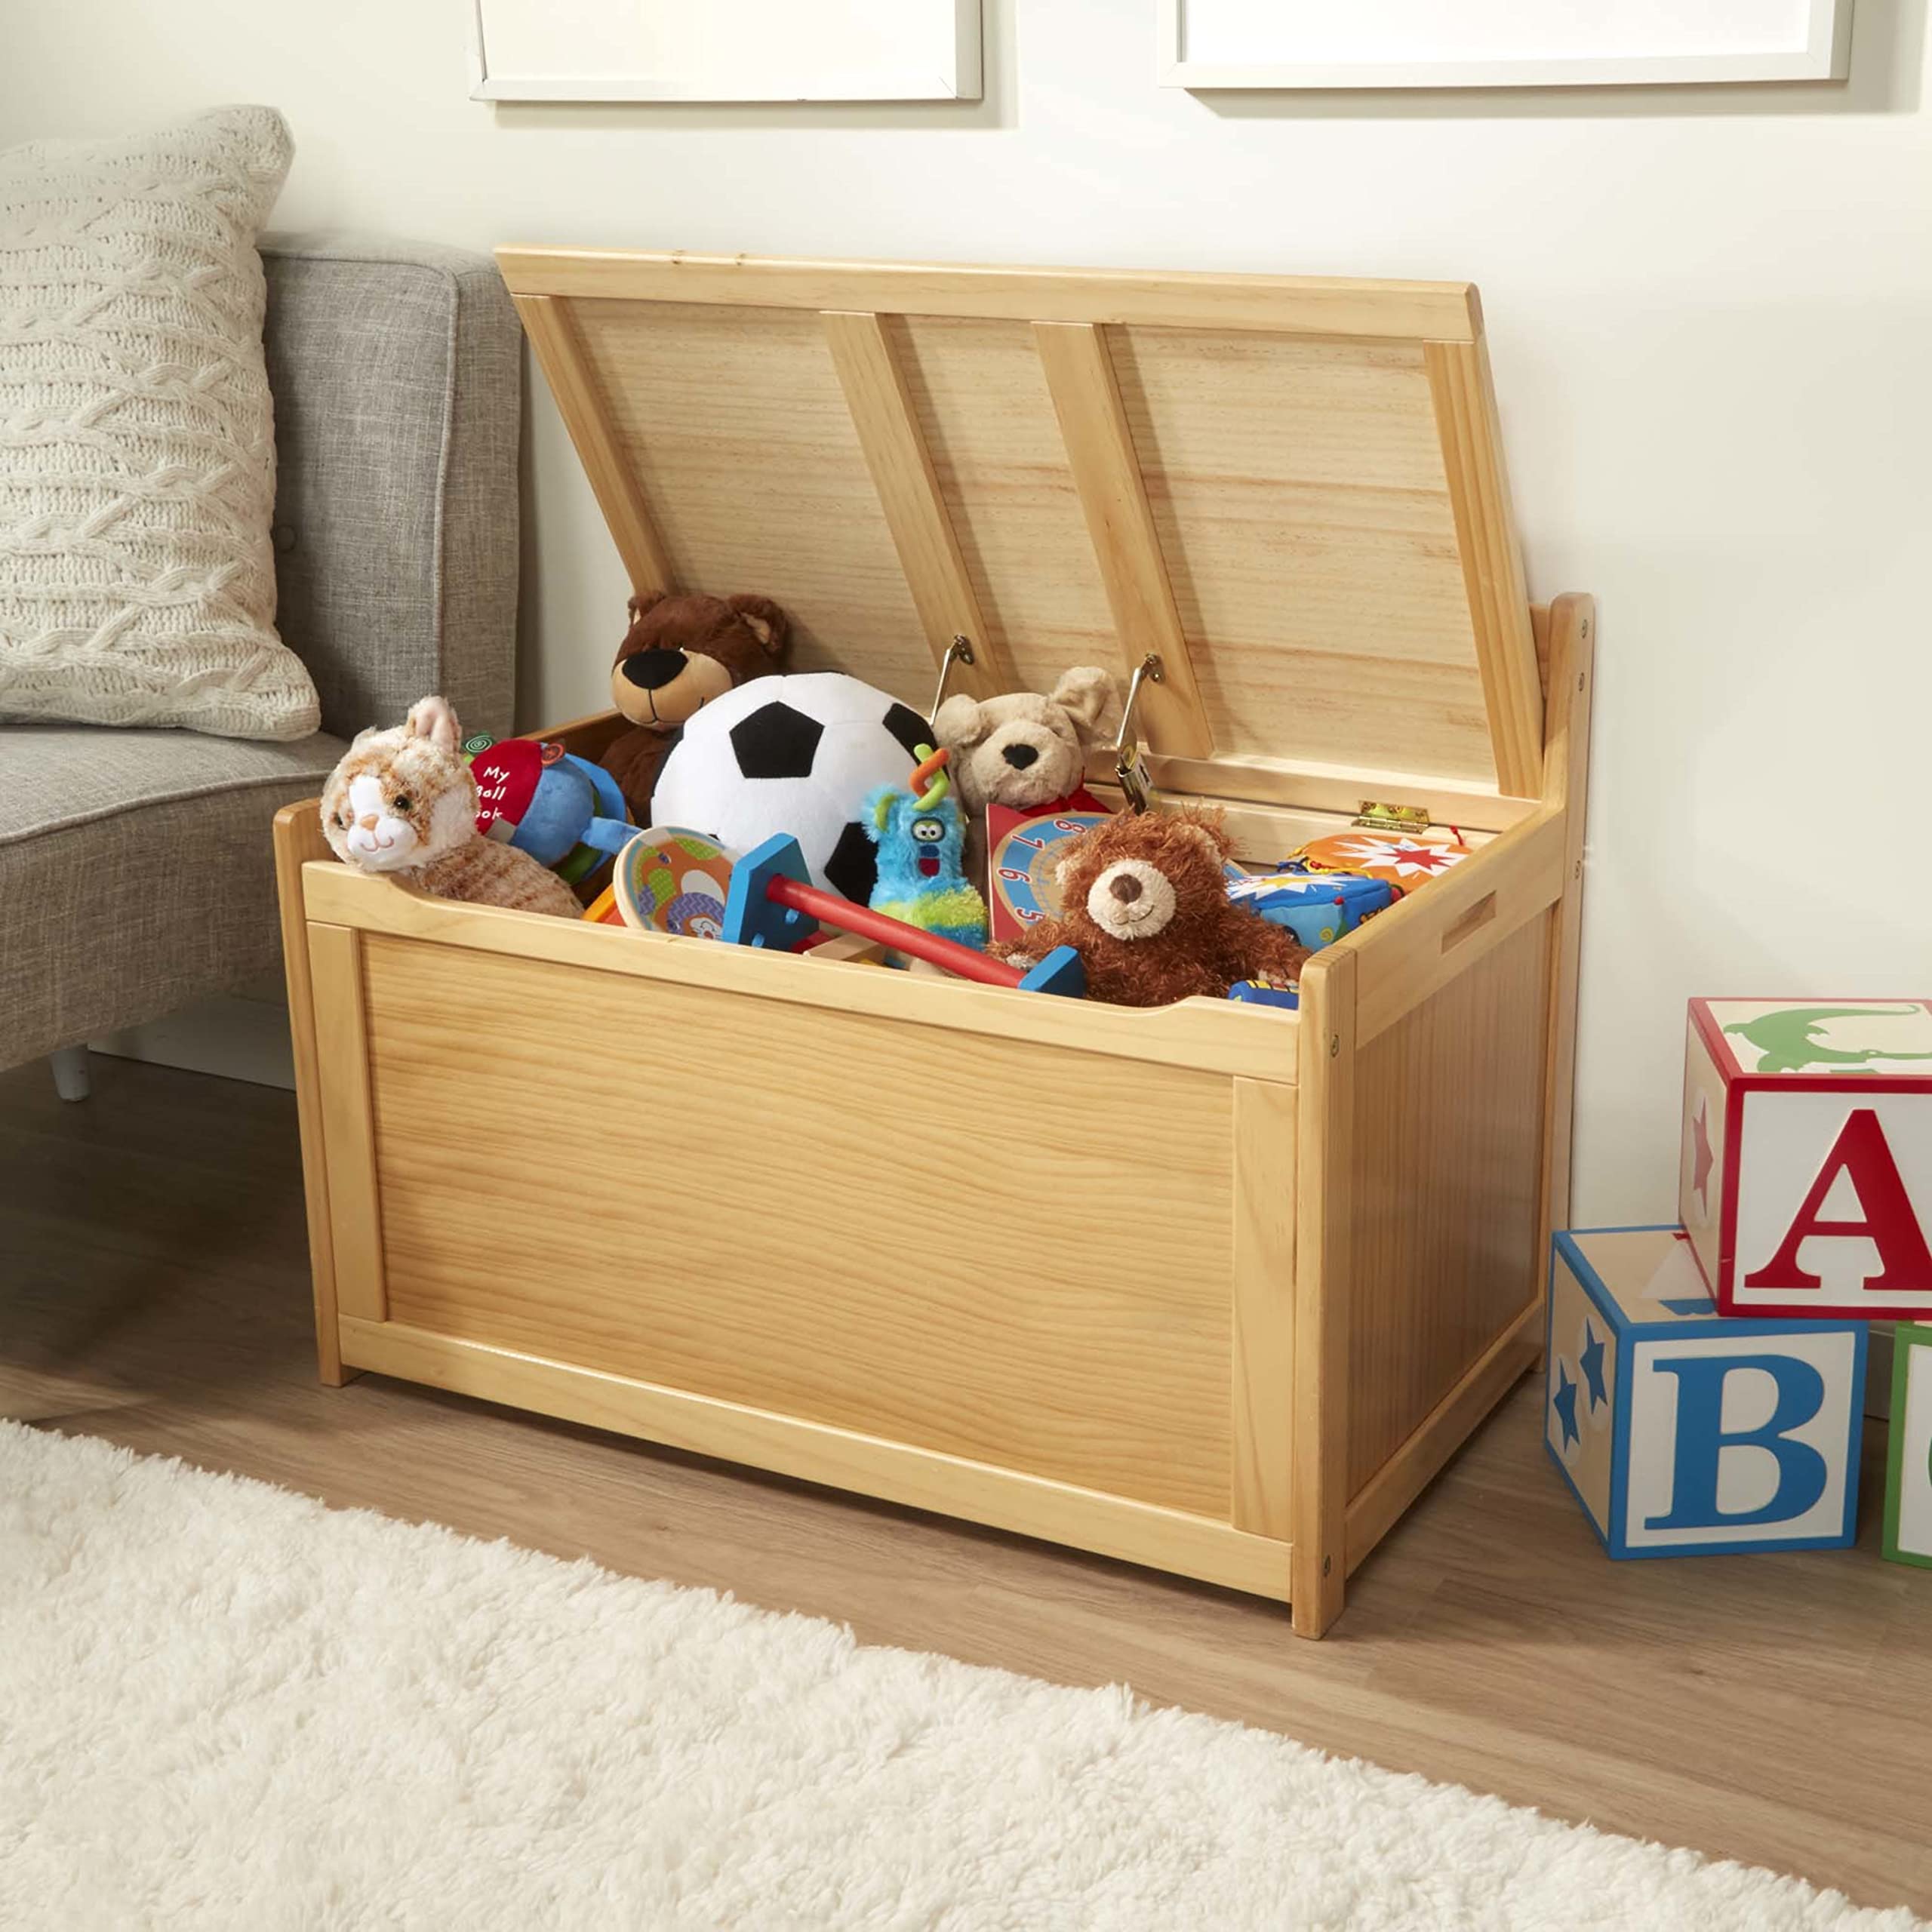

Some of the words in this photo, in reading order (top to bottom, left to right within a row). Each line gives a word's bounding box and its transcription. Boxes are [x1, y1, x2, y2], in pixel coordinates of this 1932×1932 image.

[483, 766, 510, 784] My
[1054, 819, 1087, 834] 8
[1011, 834, 1045, 851] 7
[998, 868, 1032, 883] 6
[1016, 907, 1045, 922] 5
[1744, 1109, 1932, 1291] A
[1644, 1355, 1827, 1530] B
